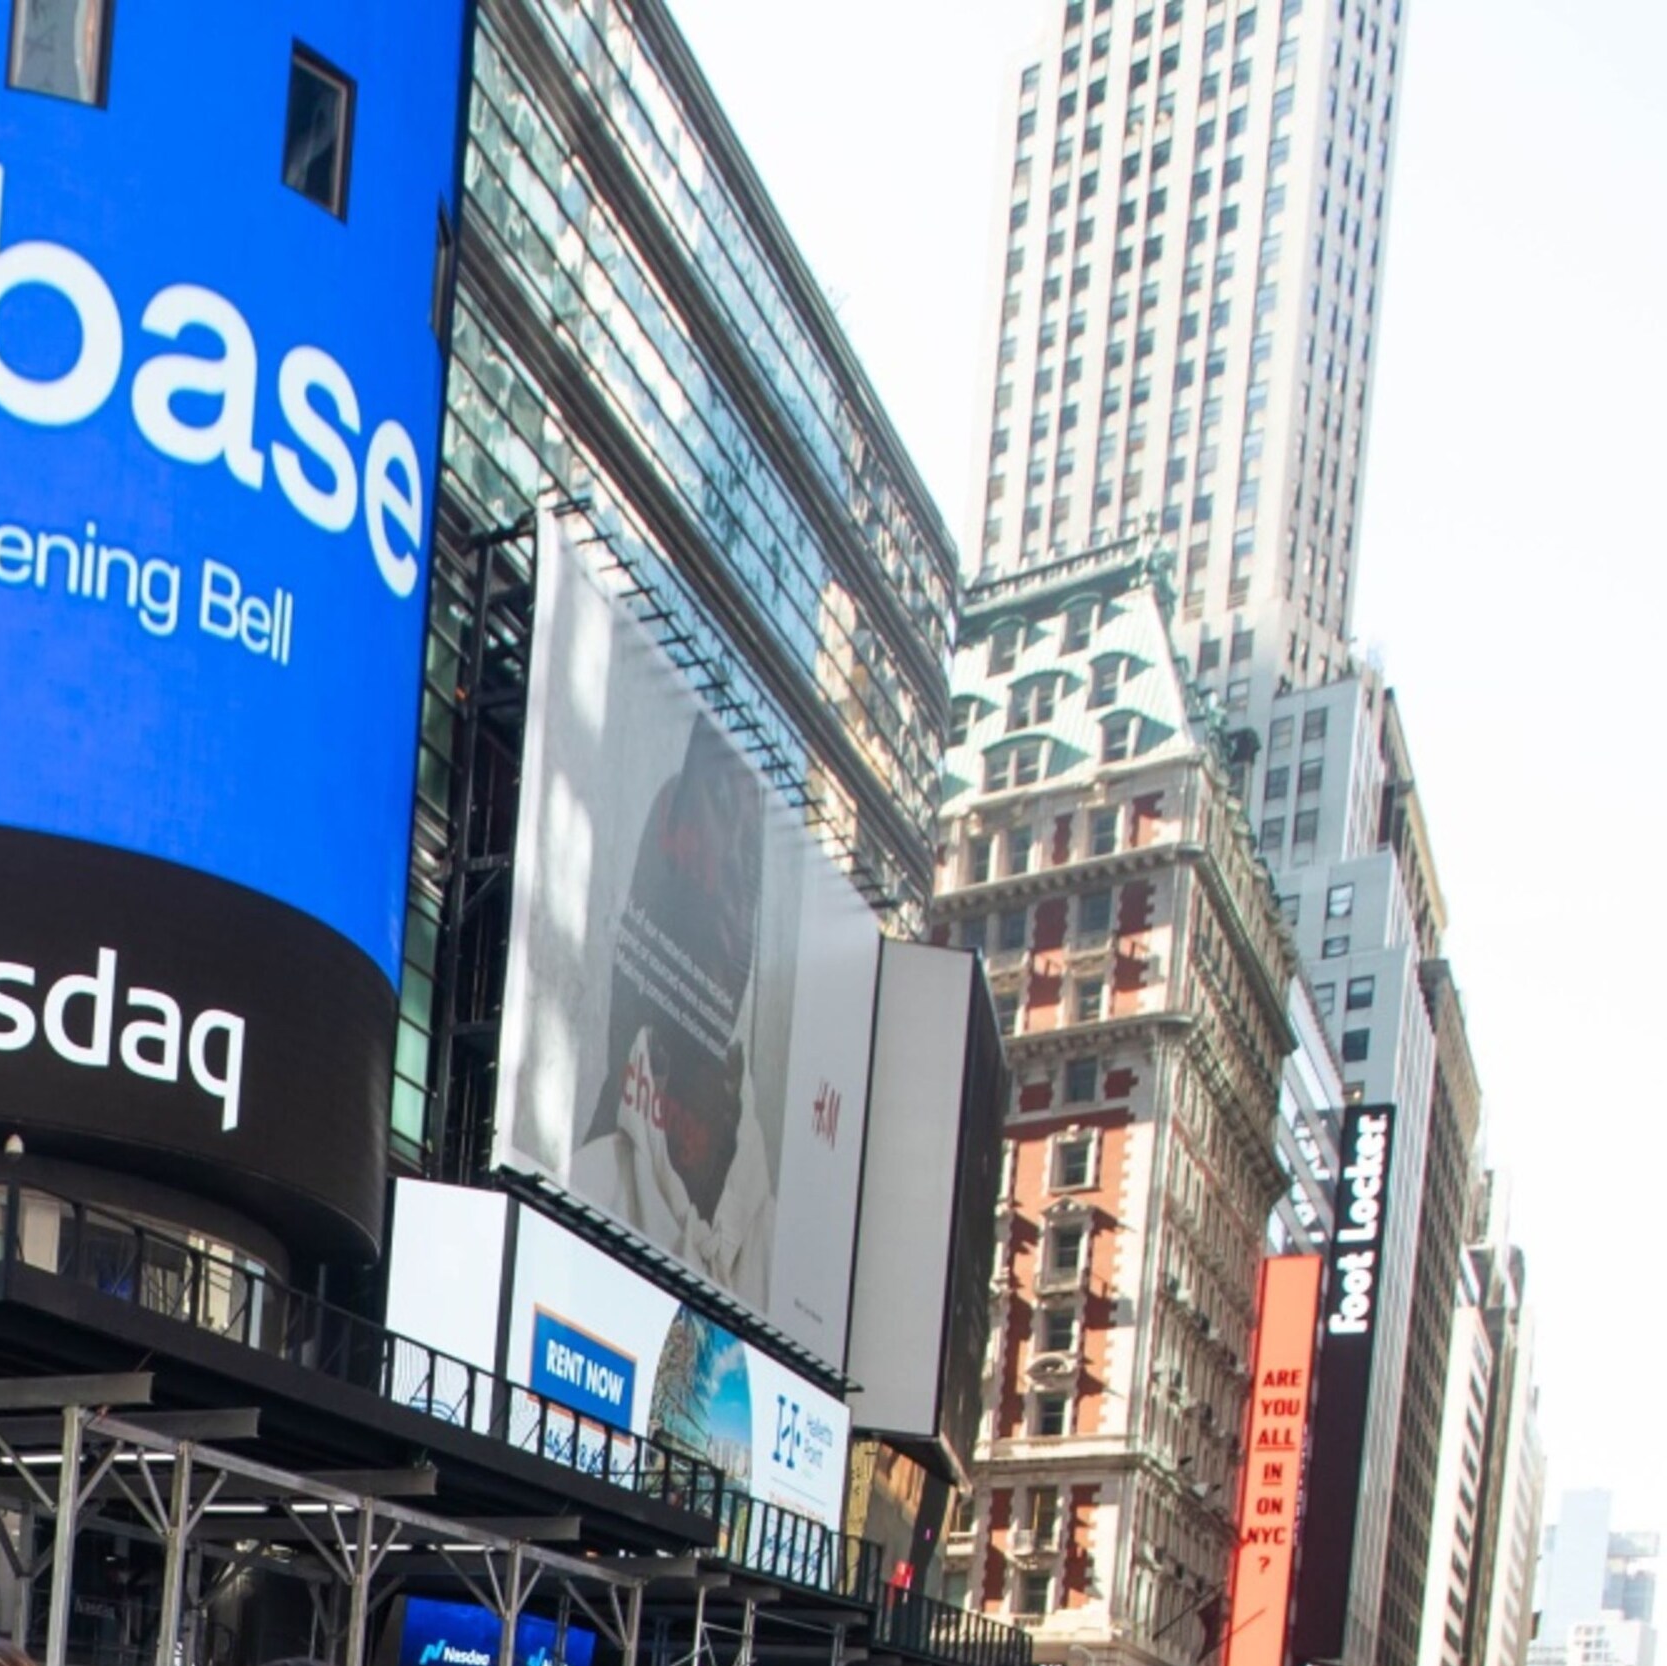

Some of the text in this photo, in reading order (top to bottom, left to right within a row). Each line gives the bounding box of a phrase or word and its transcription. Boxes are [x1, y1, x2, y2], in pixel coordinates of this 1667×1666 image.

[199, 559, 294, 667] Bell
[1328, 1113, 1388, 1334] Foot Locker
[546, 1338, 625, 1406] RENT NOW
[1262, 1369, 1302, 1388] ARE
[1261, 1398, 1301, 1417] YOU
[1256, 1427, 1295, 1446] ALL
[1263, 1463, 1283, 1480] IN
[1256, 1497, 1283, 1516] ON
[1246, 1526, 1287, 1545] NYC
